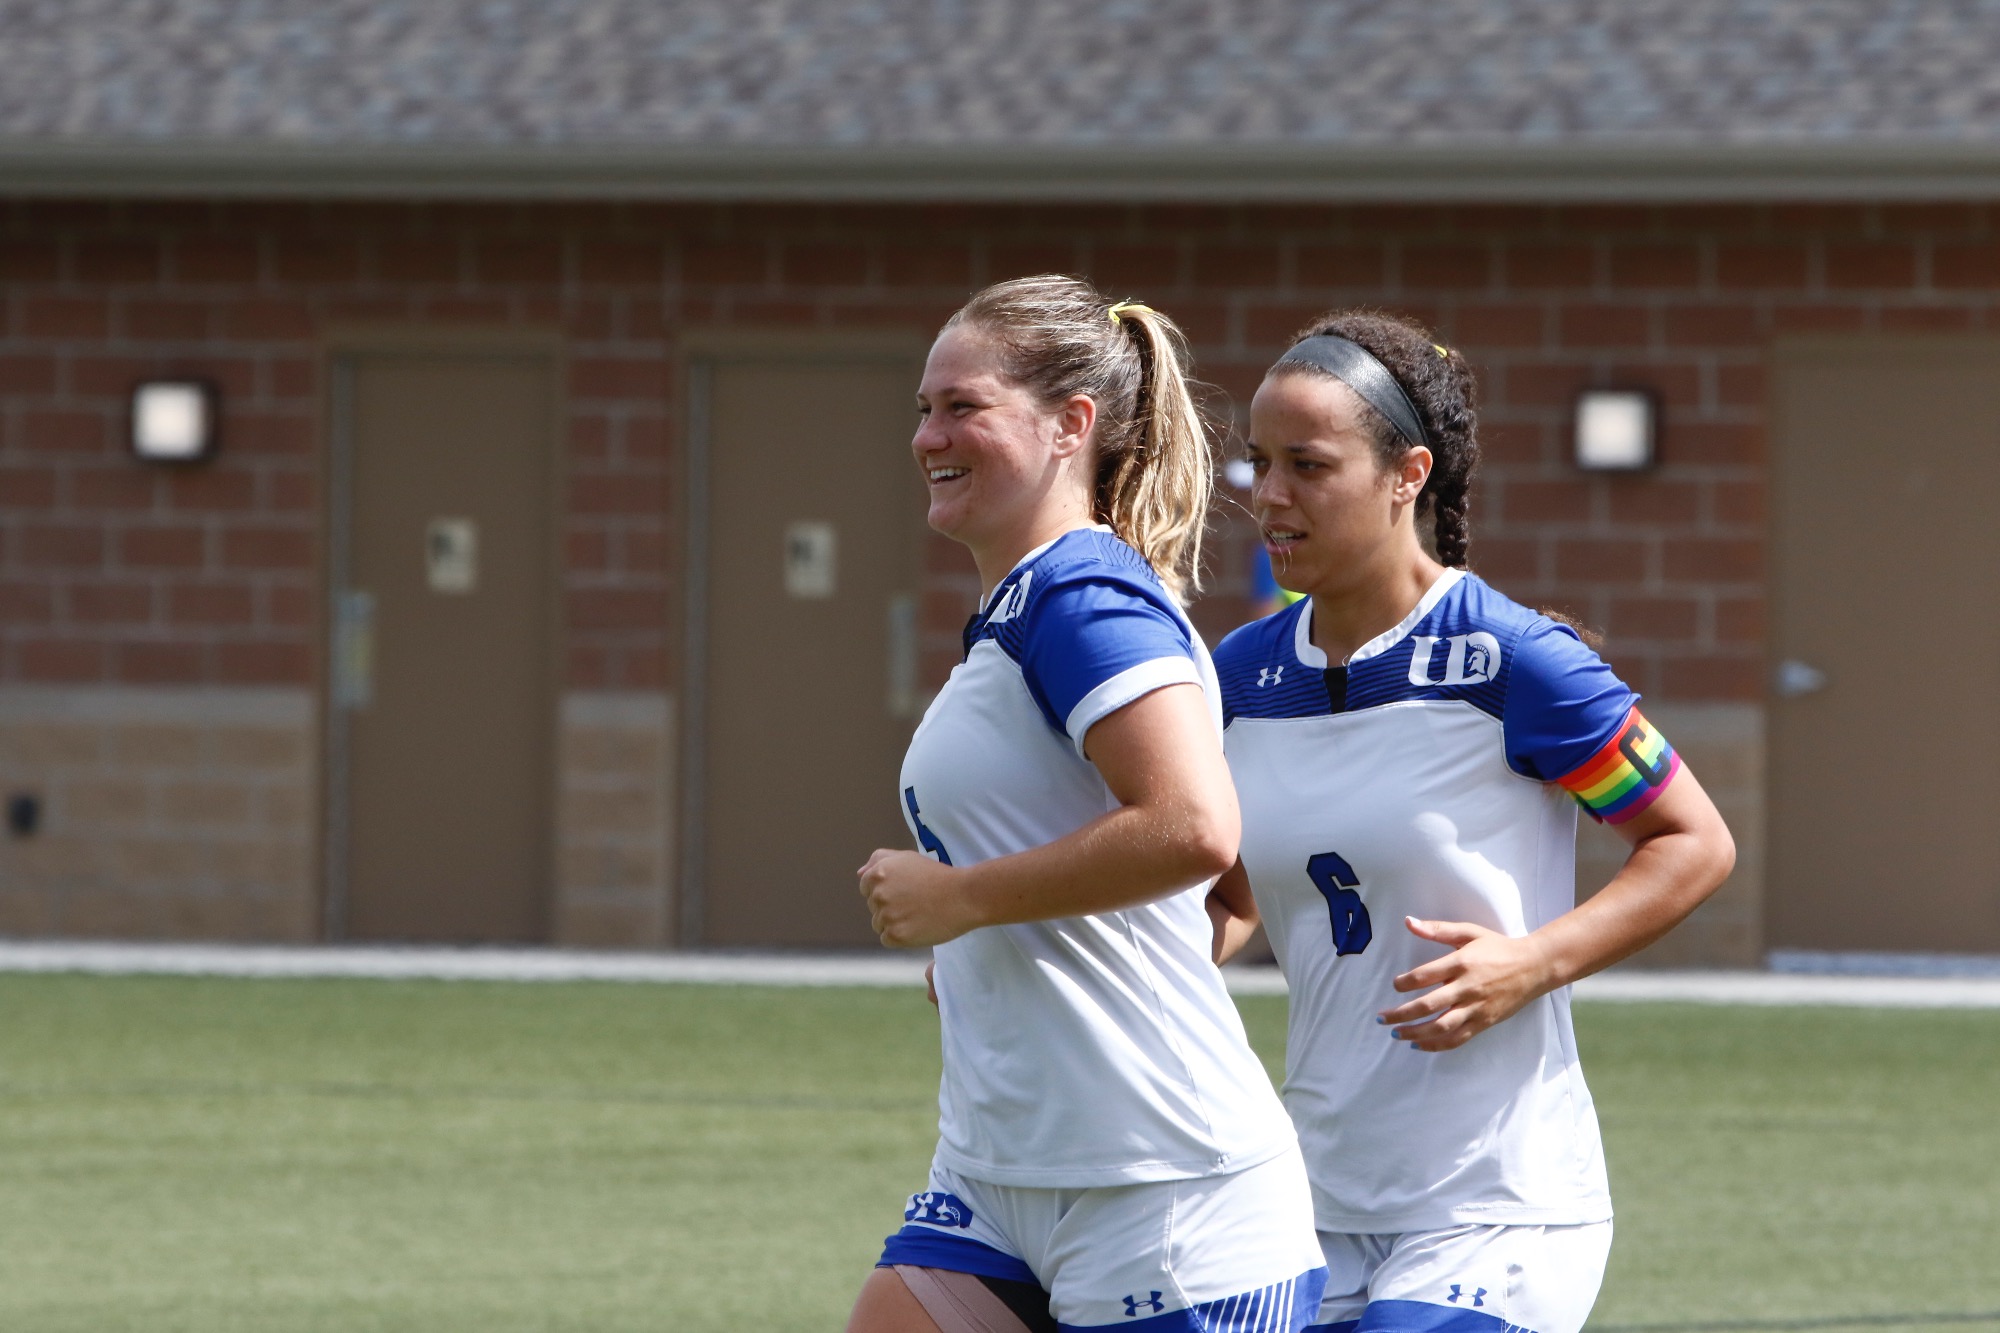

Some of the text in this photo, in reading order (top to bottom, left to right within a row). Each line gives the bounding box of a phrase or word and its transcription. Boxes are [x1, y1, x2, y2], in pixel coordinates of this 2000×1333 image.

[1408, 631, 1501, 687] UD
[1618, 723, 1672, 788] C
[1306, 852, 1373, 957] 6
